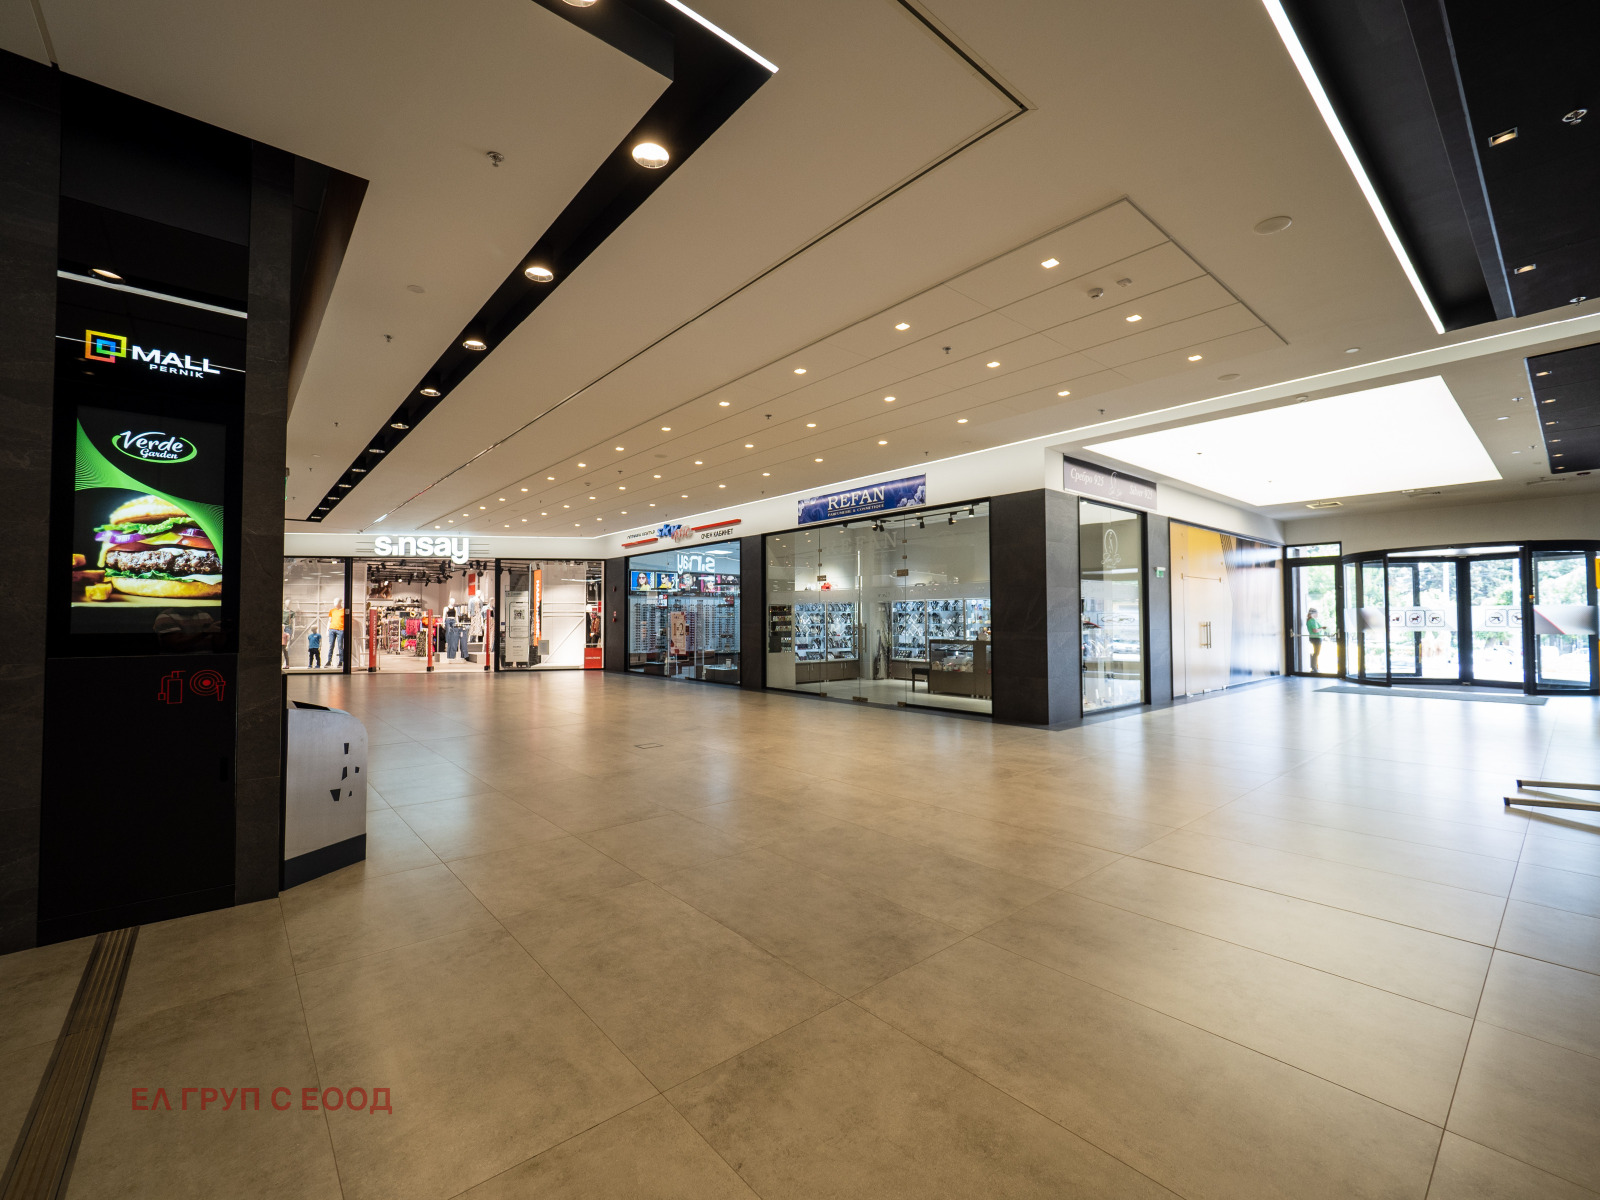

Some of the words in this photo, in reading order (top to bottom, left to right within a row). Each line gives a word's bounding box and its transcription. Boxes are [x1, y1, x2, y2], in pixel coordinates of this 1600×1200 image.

[132, 345, 220, 374] MALL
[149, 363, 204, 379] PERNIK
[120, 430, 184, 453] Verde
[140, 447, 178, 459] Garden
[1093, 474, 1104, 487] 925
[827, 485, 885, 510] REFAN
[713, 528, 734, 538] КАБИНЕТ
[374, 536, 469, 564] sinsay
